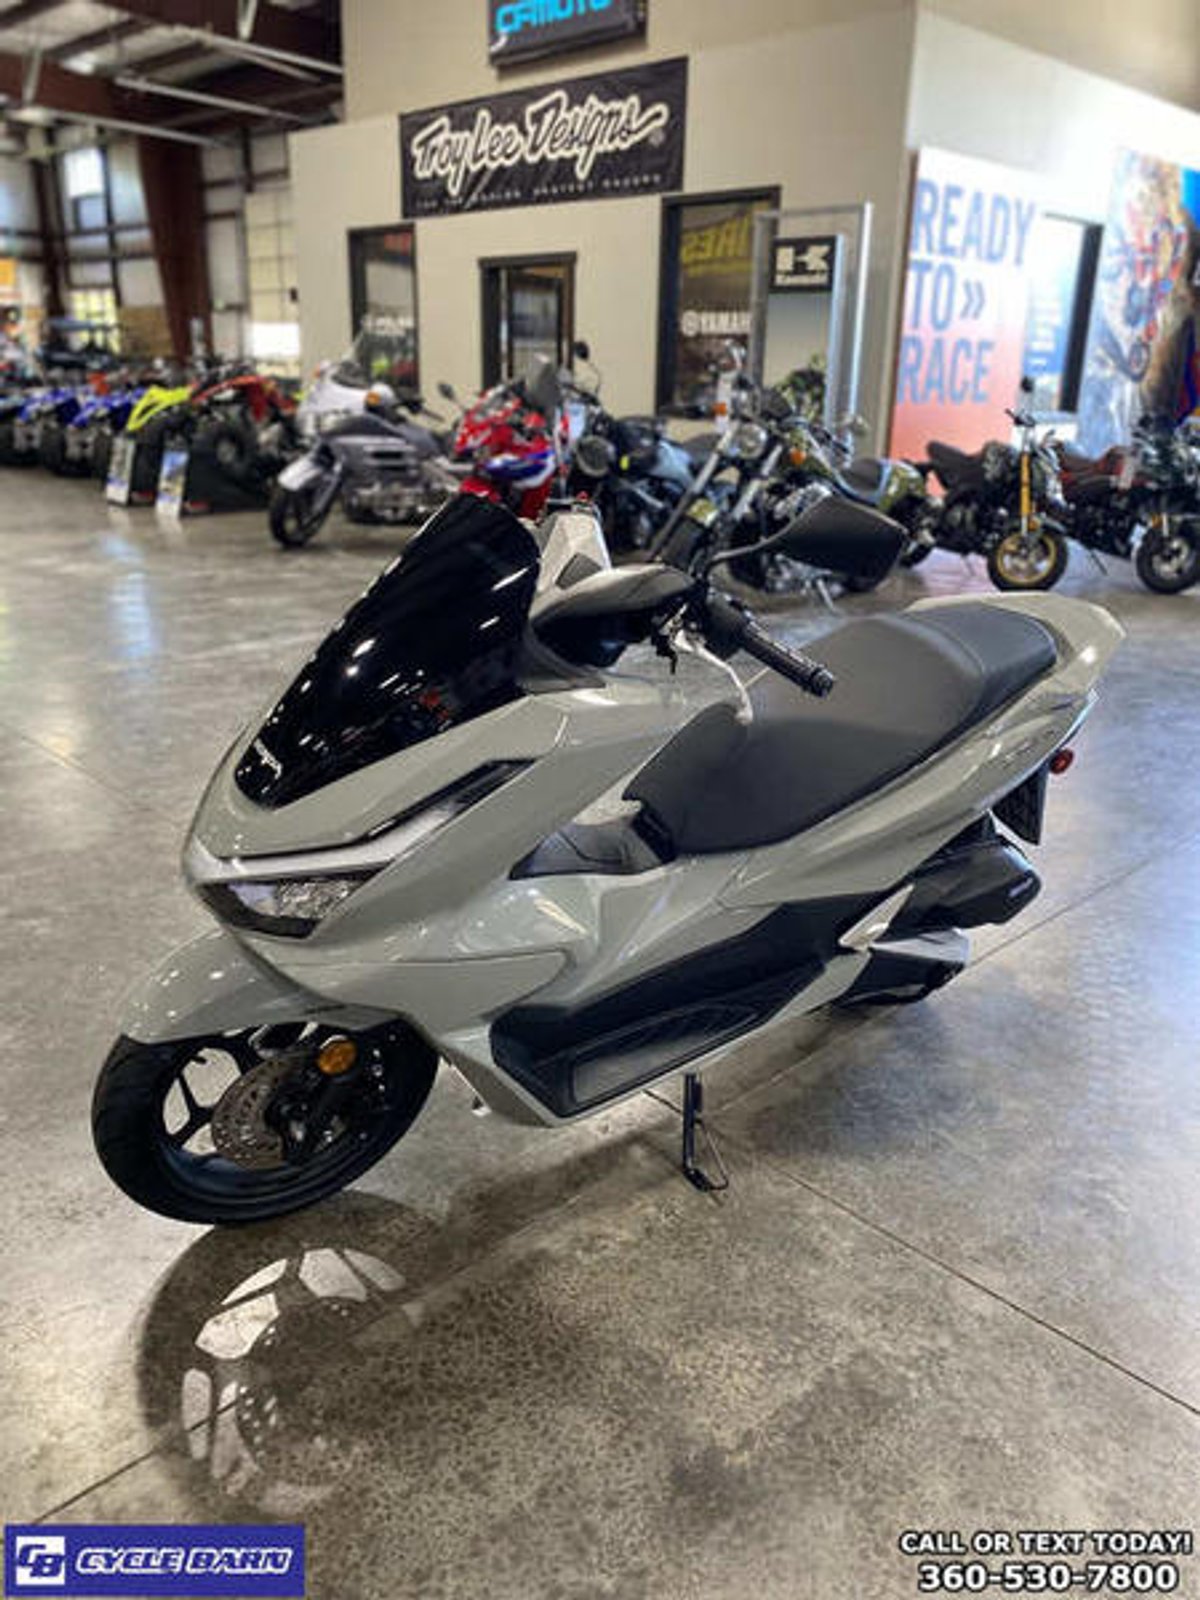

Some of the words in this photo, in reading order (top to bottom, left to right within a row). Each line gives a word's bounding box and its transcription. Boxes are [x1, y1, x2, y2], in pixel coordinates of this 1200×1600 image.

[524, 89, 669, 181] Designs
[911, 177, 1035, 267] READY
[908, 258, 957, 332] TO
[897, 335, 996, 406] RACE
